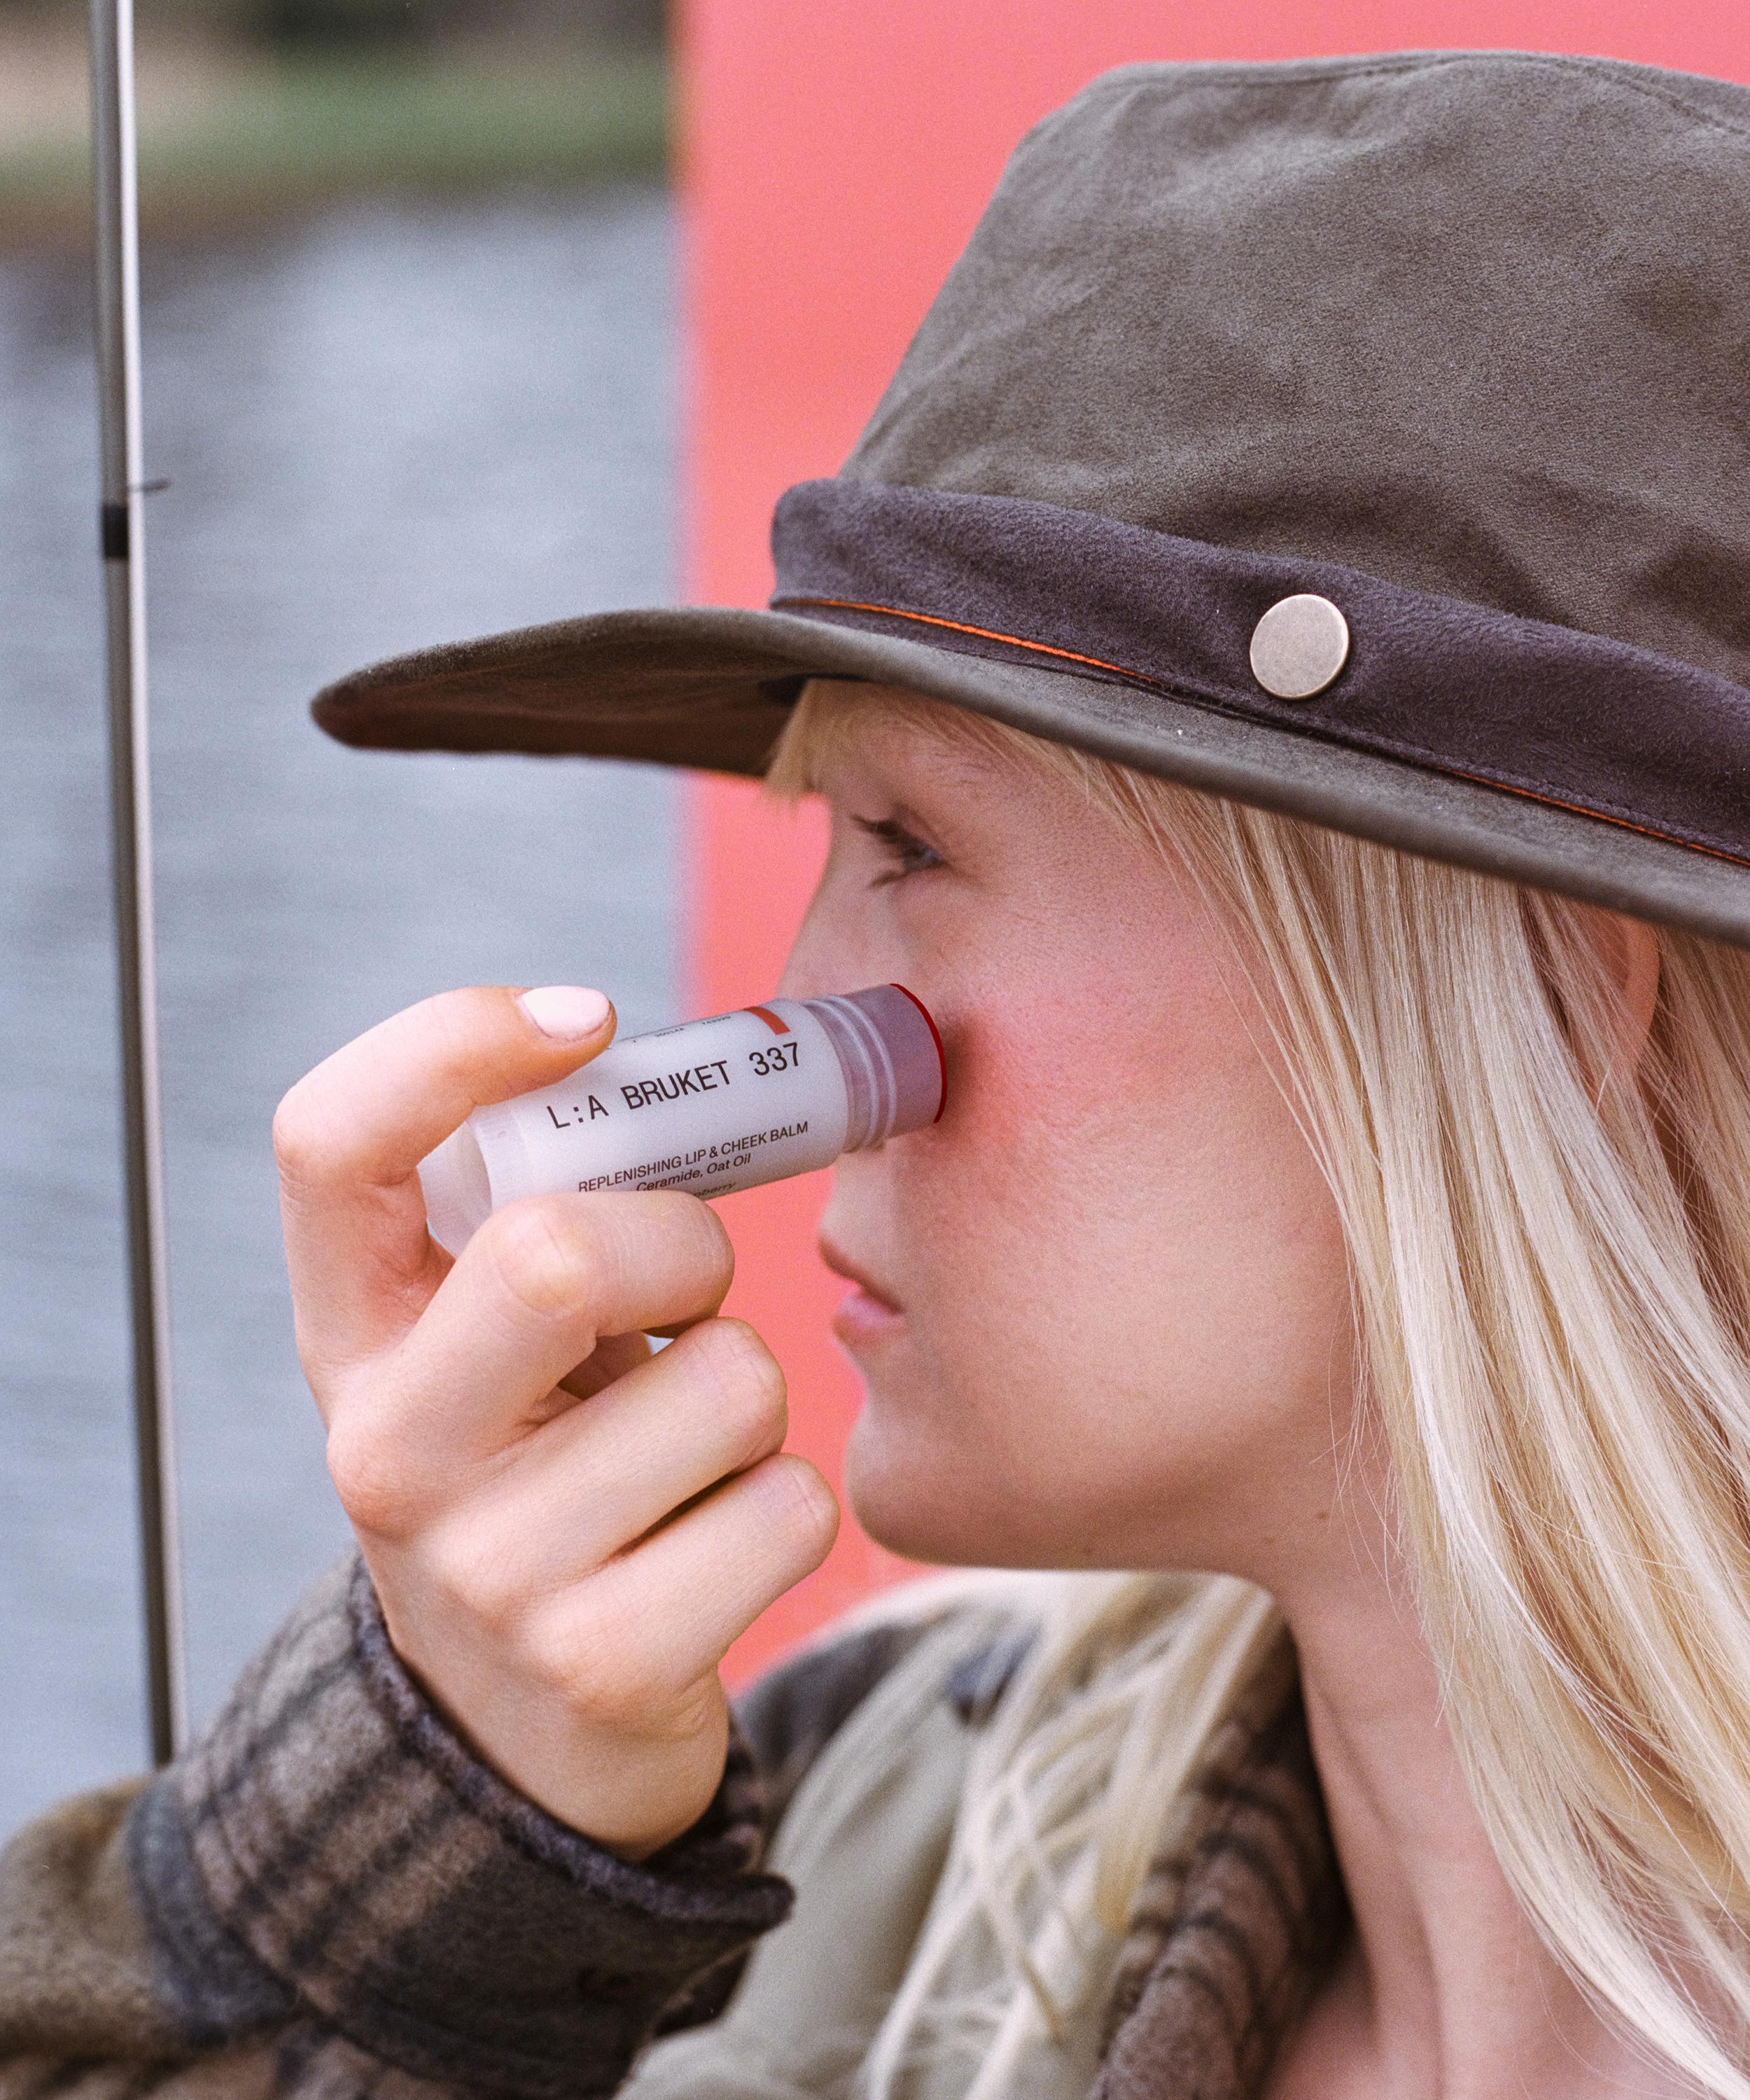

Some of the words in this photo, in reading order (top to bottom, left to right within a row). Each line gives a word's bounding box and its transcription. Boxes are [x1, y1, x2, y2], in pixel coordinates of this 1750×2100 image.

[547, 1095, 609, 1128] L:A
[621, 1060, 730, 1110] BRUKET
[749, 1042, 799, 1076] 337
[578, 1156, 682, 1192] REPLENISHING
[685, 1149, 706, 1166] LIP
[709, 1146, 718, 1158] &
[721, 1132, 767, 1155] CHEEK
[770, 1121, 808, 1142] BALM
[636, 1168, 703, 1191] Ceramide,
[706, 1159, 730, 1175] Oat
[733, 1153, 751, 1167] Oil
